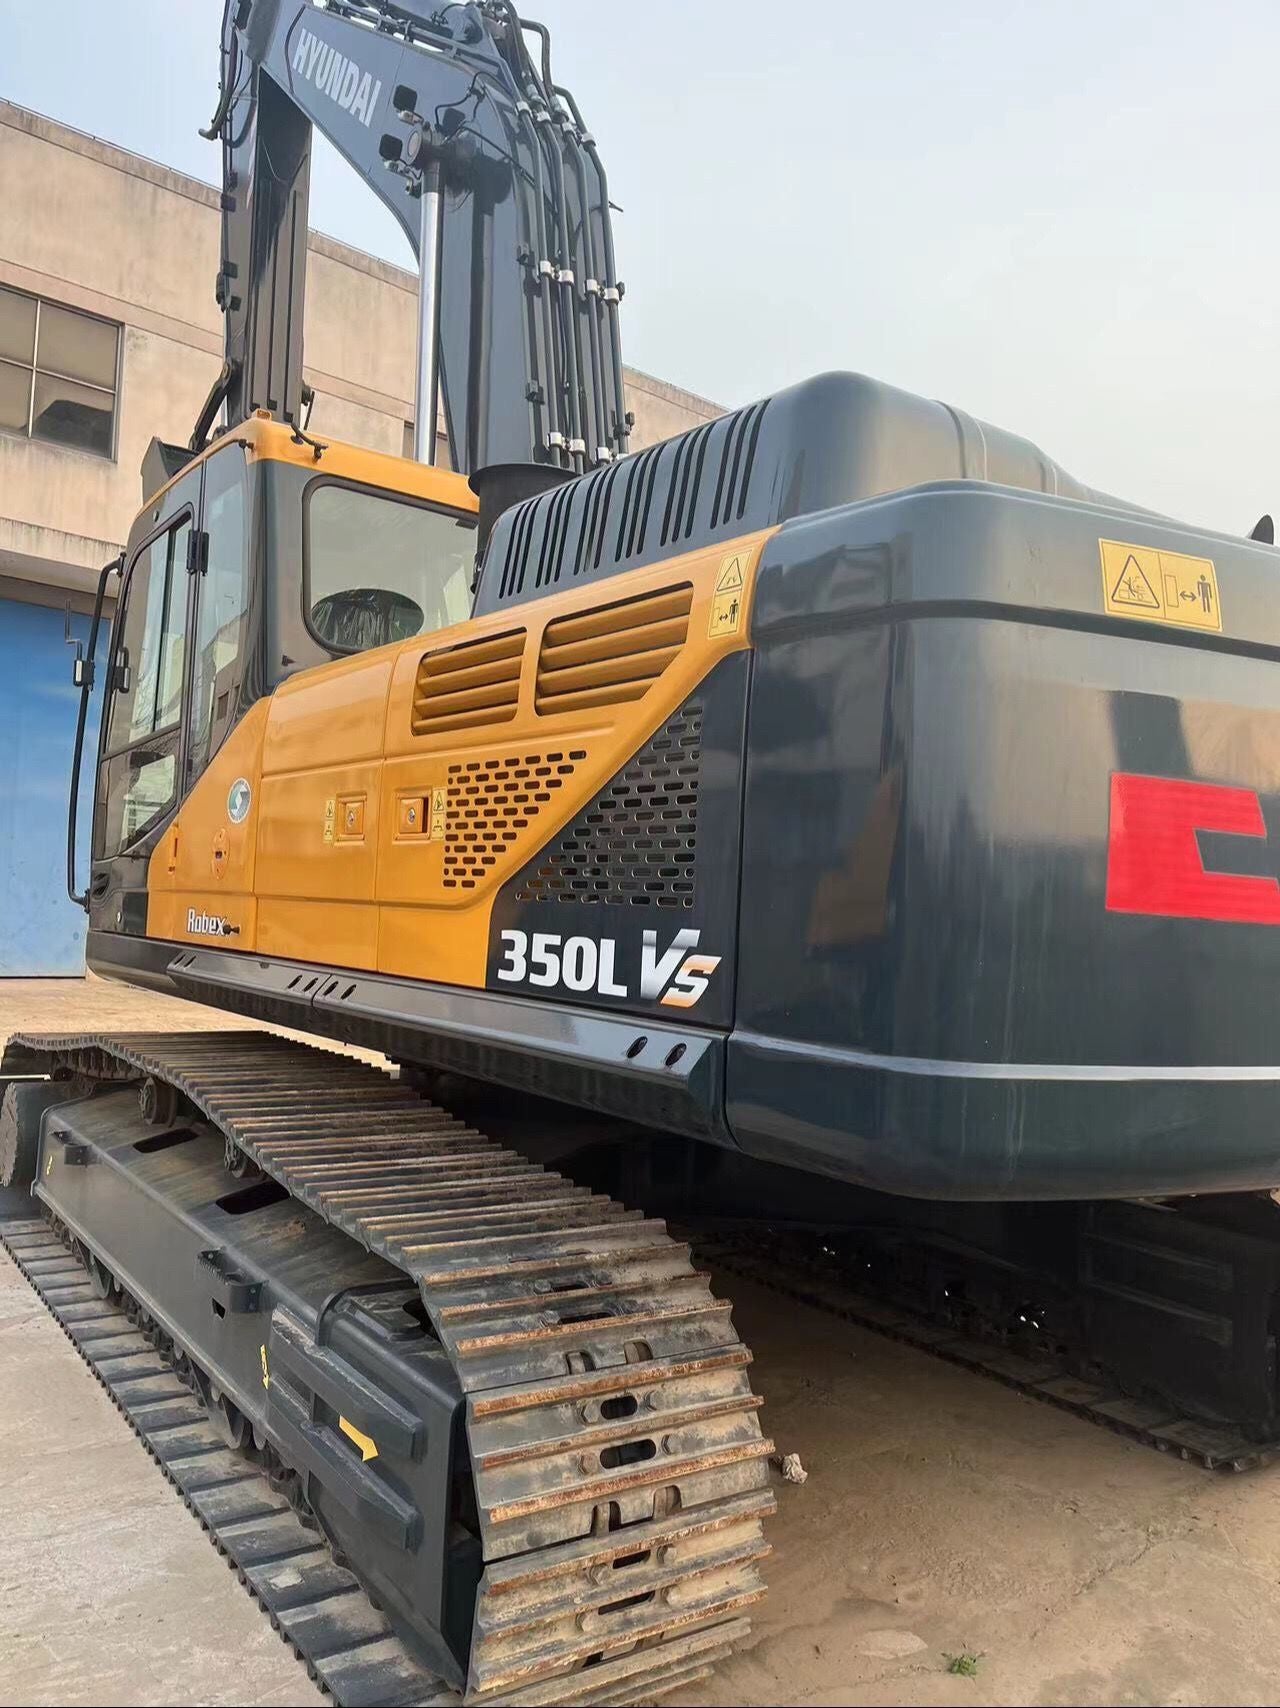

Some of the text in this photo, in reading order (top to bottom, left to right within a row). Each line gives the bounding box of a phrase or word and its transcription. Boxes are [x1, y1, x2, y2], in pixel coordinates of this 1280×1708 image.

[292, 27, 382, 128] HYUNDAI
[186, 907, 226, 936] Robex
[497, 929, 628, 997] 350L
